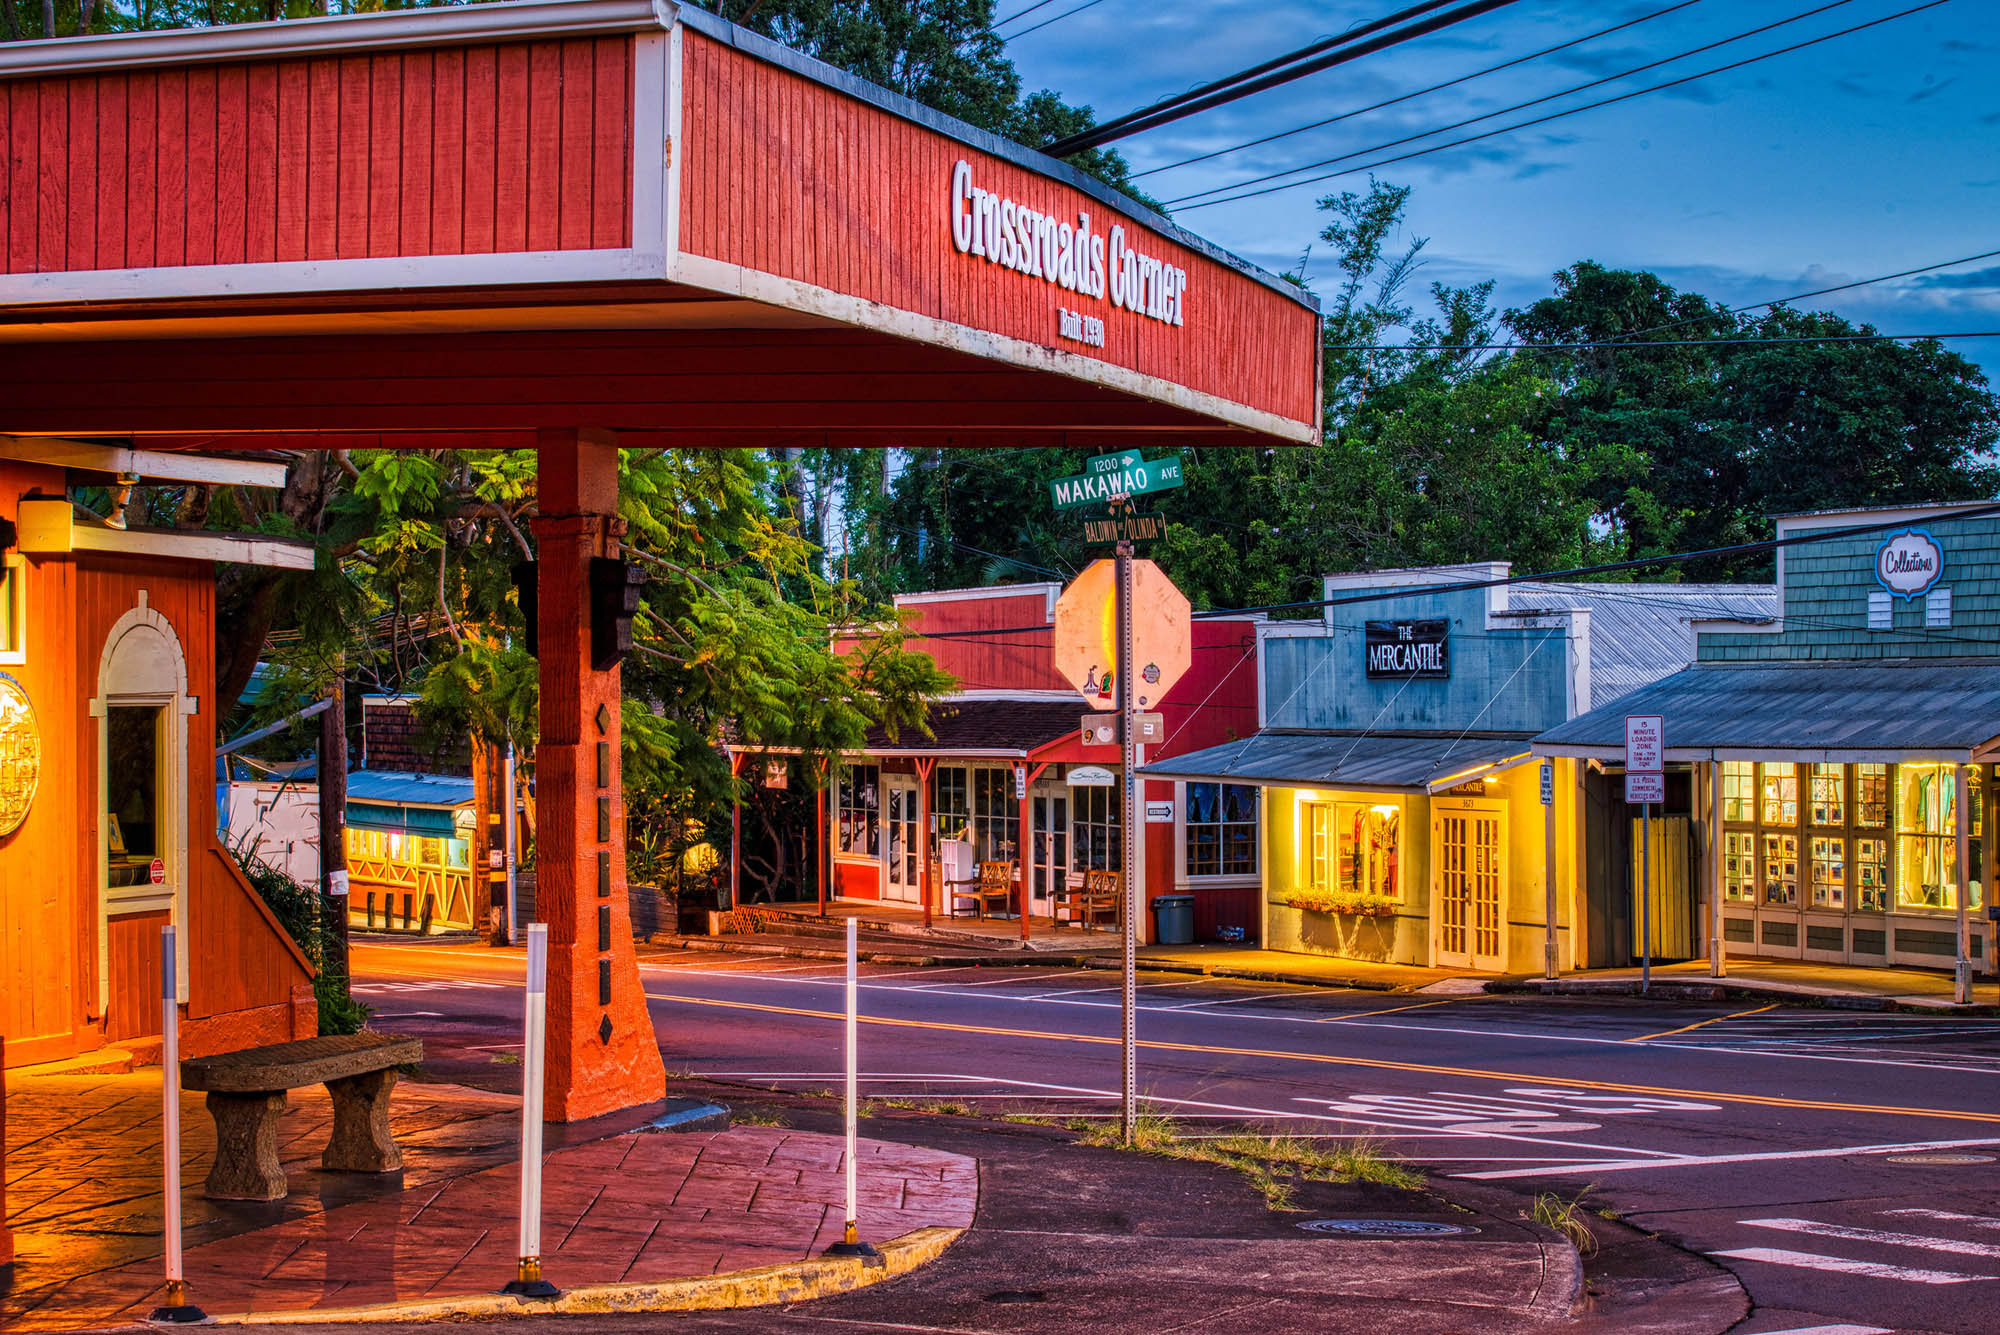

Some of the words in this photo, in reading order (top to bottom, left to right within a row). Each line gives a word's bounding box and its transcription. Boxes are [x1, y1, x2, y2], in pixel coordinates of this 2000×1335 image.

[952, 159, 1105, 300] Crossroads
[1109, 224, 1186, 327] Corner
[1058, 307, 1082, 341] Built
[1083, 314, 1104, 348] 1930
[1095, 457, 1118, 473] 1200
[1055, 467, 1147, 505] MAKAWAO
[1161, 466, 1180, 480] AVE
[1084, 520, 1118, 543] BALDWIN
[1128, 517, 1159, 540] OLINDA
[1885, 550, 1933, 574] Collections
[1397, 625, 1413, 640] THE
[1369, 643, 1443, 671] MERCANTILE
